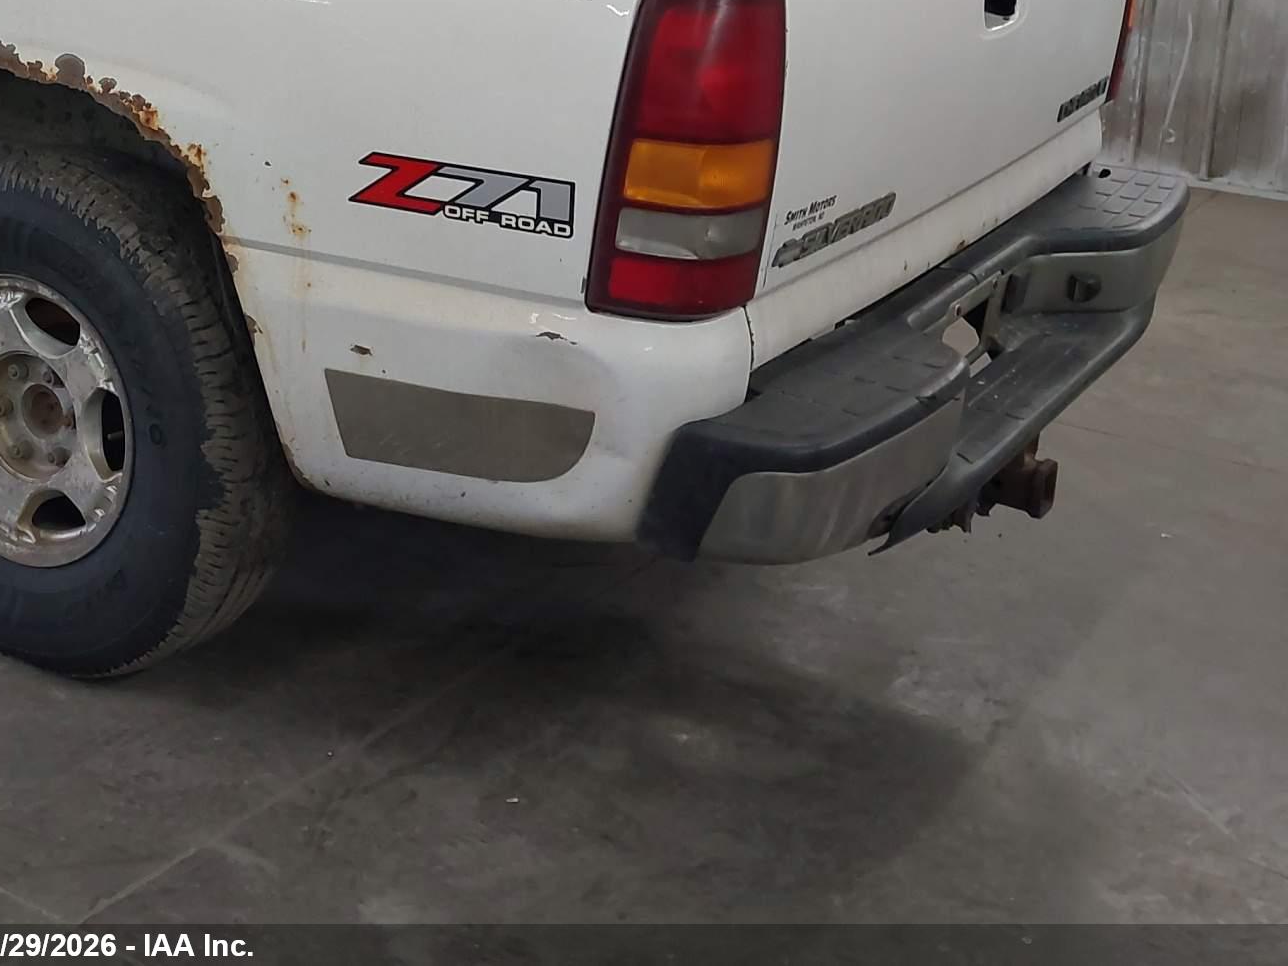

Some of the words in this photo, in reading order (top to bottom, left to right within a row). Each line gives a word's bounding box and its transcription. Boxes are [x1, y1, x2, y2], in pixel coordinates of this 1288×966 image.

[347, 151, 576, 224] Z71
[443, 204, 490, 223] OFF
[500, 213, 572, 237] ROAD
